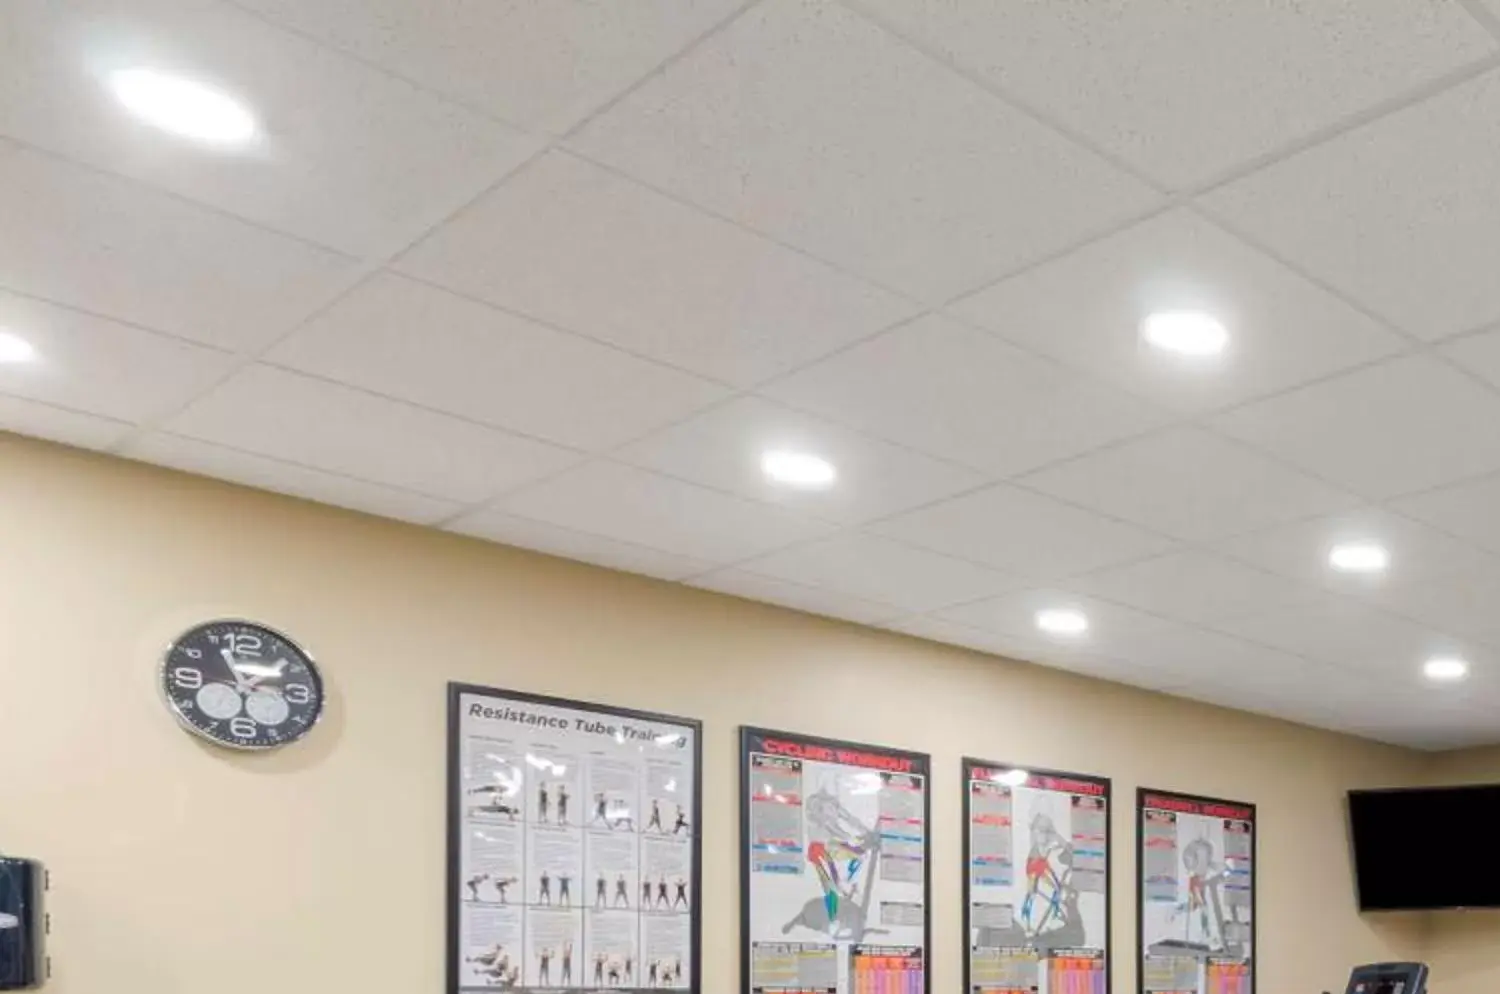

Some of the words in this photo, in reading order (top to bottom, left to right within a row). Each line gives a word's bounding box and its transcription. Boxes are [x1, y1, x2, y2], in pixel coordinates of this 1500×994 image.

[223, 633, 262, 656] 12
[175, 667, 203, 689] 9
[285, 683, 309, 705] 3
[230, 717, 257, 739] 6
[468, 702, 569, 730] Resistance
[575, 719, 617, 736] Tube
